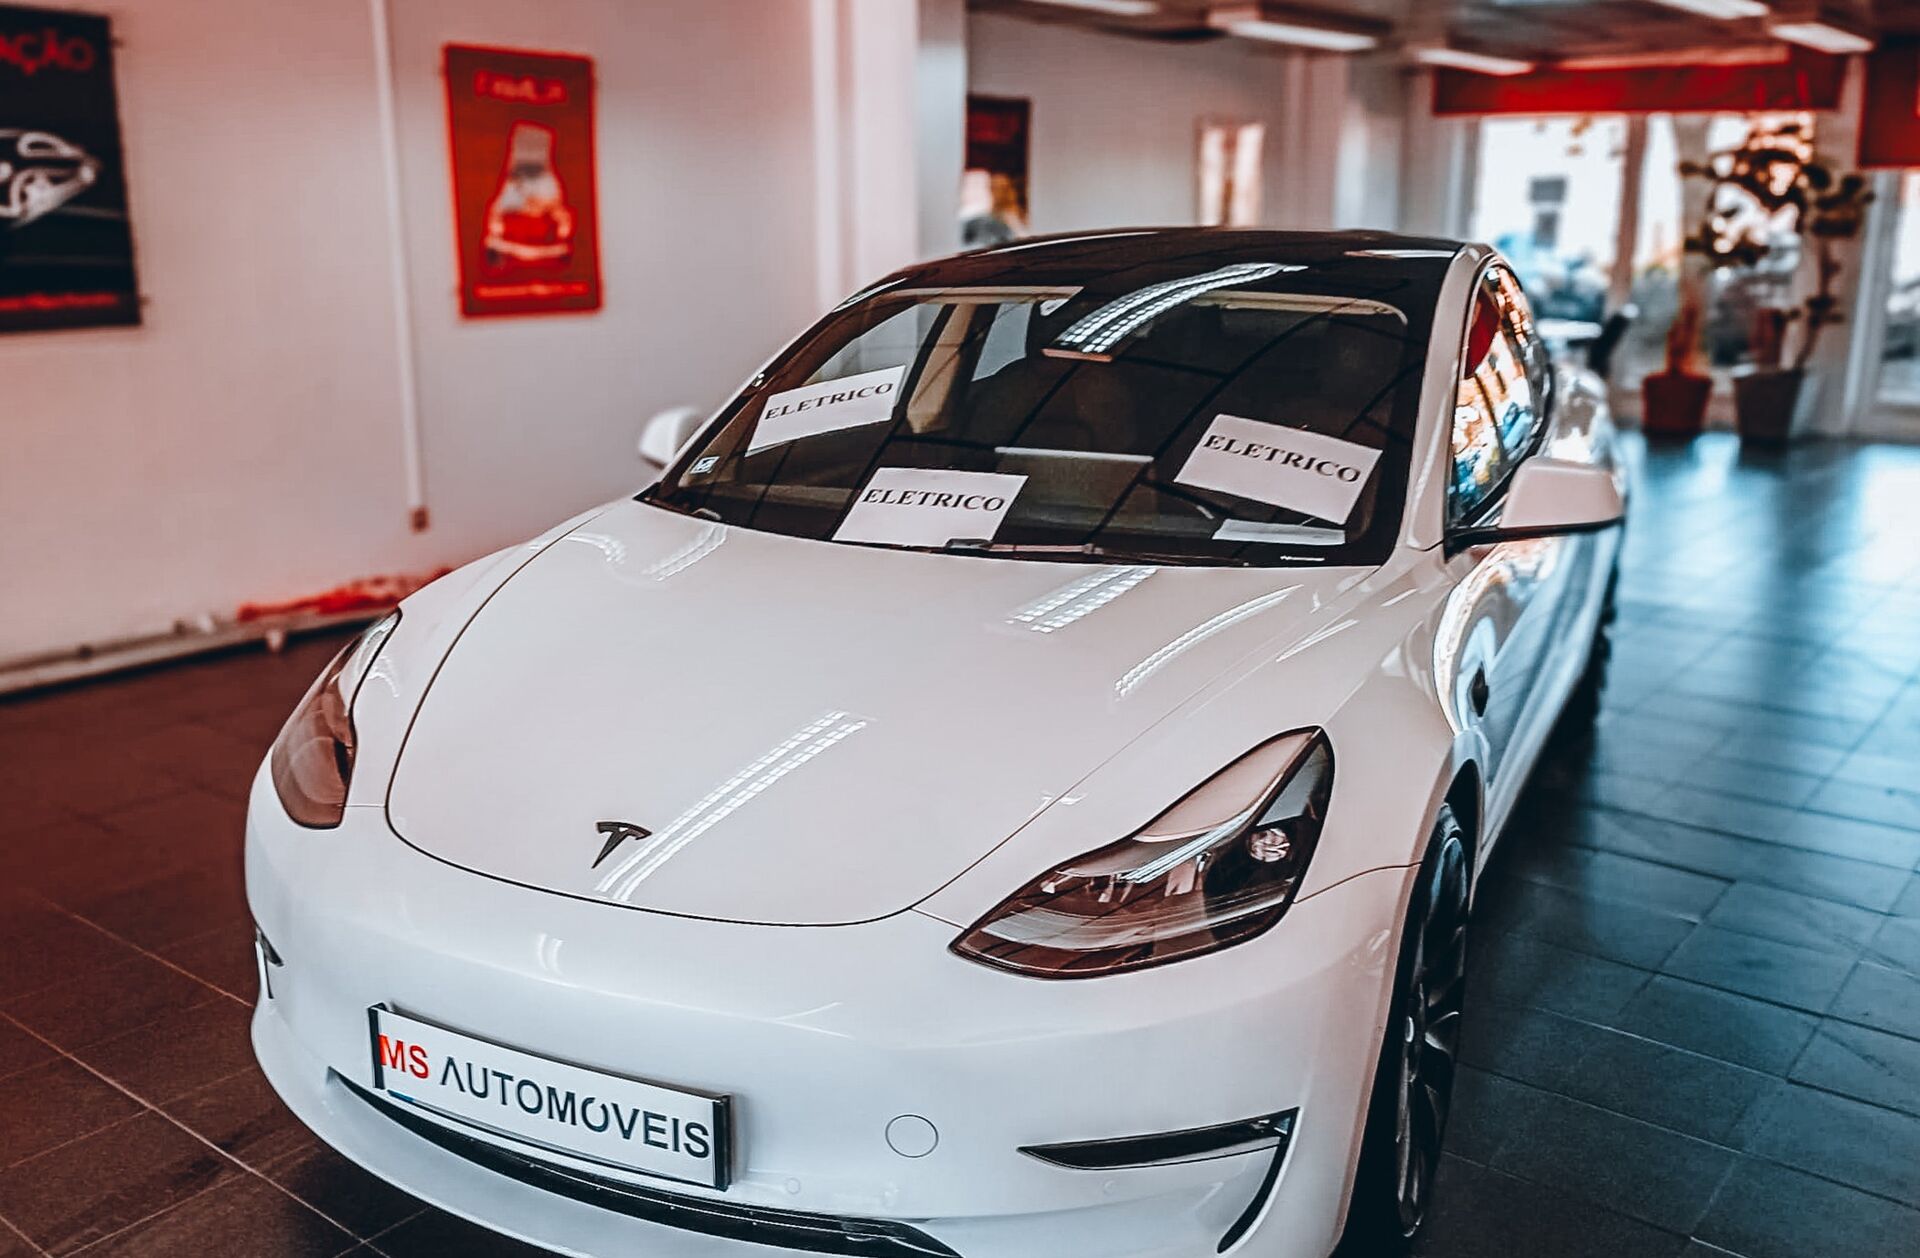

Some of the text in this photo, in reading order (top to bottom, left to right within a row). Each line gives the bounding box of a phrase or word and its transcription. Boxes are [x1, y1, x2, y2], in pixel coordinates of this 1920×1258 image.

[764, 382, 893, 421] ELETRICO
[1203, 434, 1361, 483] ELETRICO
[862, 488, 1006, 512] ELETRICO
[378, 1034, 429, 1079] MS
